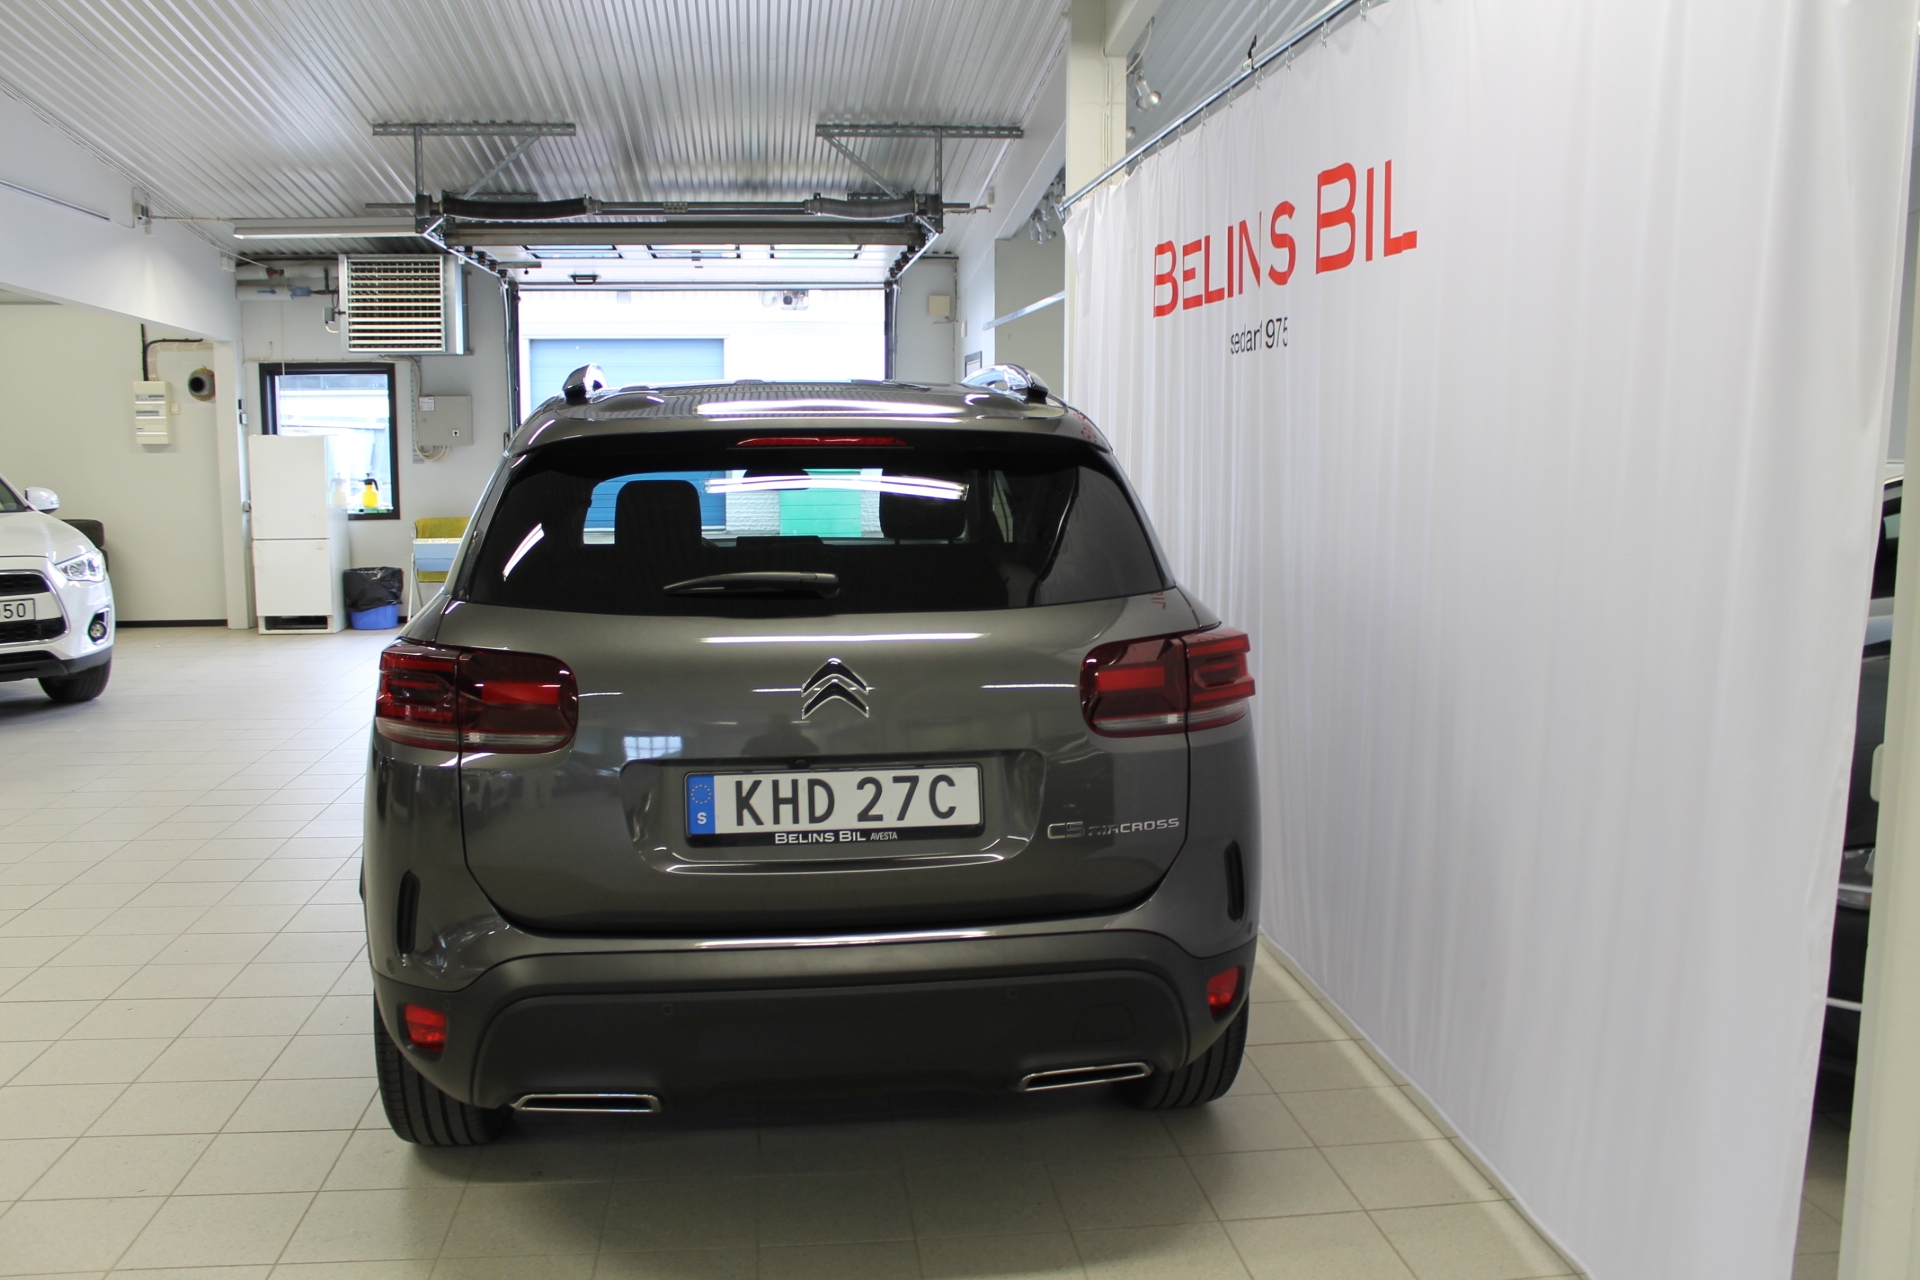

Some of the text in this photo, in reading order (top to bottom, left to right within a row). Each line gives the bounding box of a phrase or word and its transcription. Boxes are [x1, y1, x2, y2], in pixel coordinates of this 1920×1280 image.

[1153, 159, 1418, 318] BELINS BIL
[0, 602, 26, 619] 50
[734, 774, 957, 827] KHD 27C
[697, 811, 708, 825] S
[774, 830, 898, 844] BELINS BIL AVESTA
[1047, 817, 1180, 840] C5 AIRCROSS
